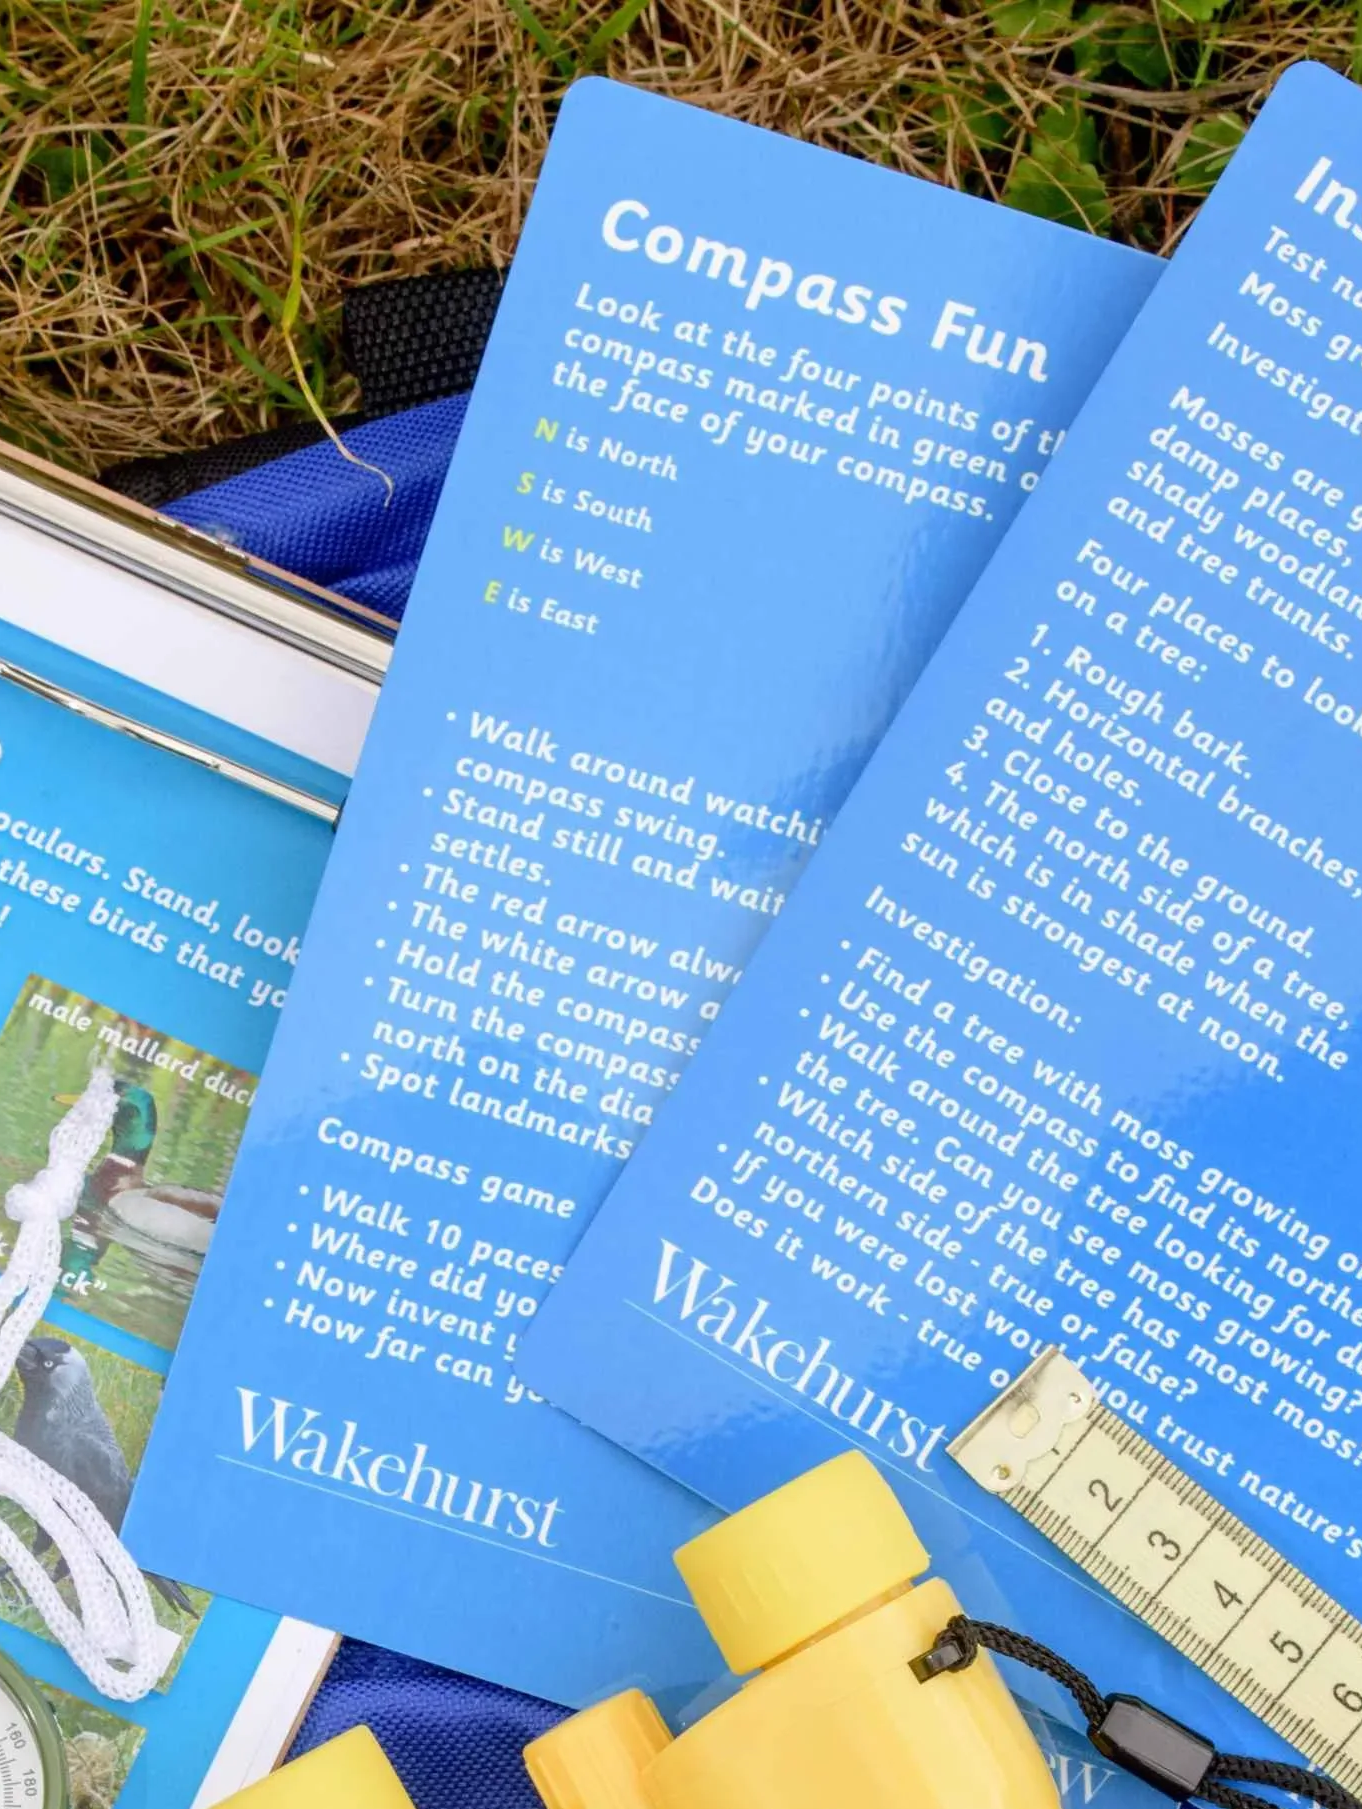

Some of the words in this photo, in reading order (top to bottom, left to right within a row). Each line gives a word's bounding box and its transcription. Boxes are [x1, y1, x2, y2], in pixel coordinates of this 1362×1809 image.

[601, 198, 909, 336] Compass
[929, 299, 1048, 383] Fun
[1263, 225, 1328, 283] Test
[1238, 270, 1323, 338] Moss
[574, 282, 663, 333] Look
[673, 320, 712, 348] at
[722, 329, 777, 366] the
[780, 341, 862, 393] four
[866, 381, 980, 432] points
[991, 418, 1034, 453] of
[535, 417, 558, 442] N
[565, 431, 590, 454] is
[598, 436, 678, 482] North
[552, 359, 608, 398] the
[609, 377, 690, 424] face
[699, 409, 744, 446] of
[743, 425, 828, 465] your
[836, 454, 995, 521] compass.
[517, 472, 535, 494] S
[541, 484, 567, 505] is
[572, 489, 652, 533] South
[503, 526, 535, 552] W
[539, 543, 564, 564] is
[574, 547, 644, 590] West
[484, 580, 503, 603] E
[507, 592, 531, 614] is
[539, 597, 599, 635] East
[88, 896, 168, 953] birds
[176, 941, 243, 988] that
[122, 866, 222, 934] Stand,
[232, 913, 302, 968] look
[864, 884, 1081, 1034] Investigation:
[900, 832, 959, 880] sun
[966, 871, 997, 900] is
[1001, 894, 1152, 997] strongest
[1156, 991, 1195, 1023] at
[1198, 1016, 1286, 1082] noon.
[28, 992, 93, 1032] male
[97, 1022, 202, 1082] mallard
[317, 1116, 471, 1186] Compass
[479, 1174, 576, 1218] game
[652, 1237, 950, 1473] Wakehurst
[235, 1384, 566, 1551] Wakehurst
[1087, 1478, 1124, 1513] 2
[1146, 1529, 1182, 1562] 3
[1211, 1579, 1244, 1610] 4
[1269, 1629, 1304, 1665] 5
[5, 1720, 28, 1751] 160
